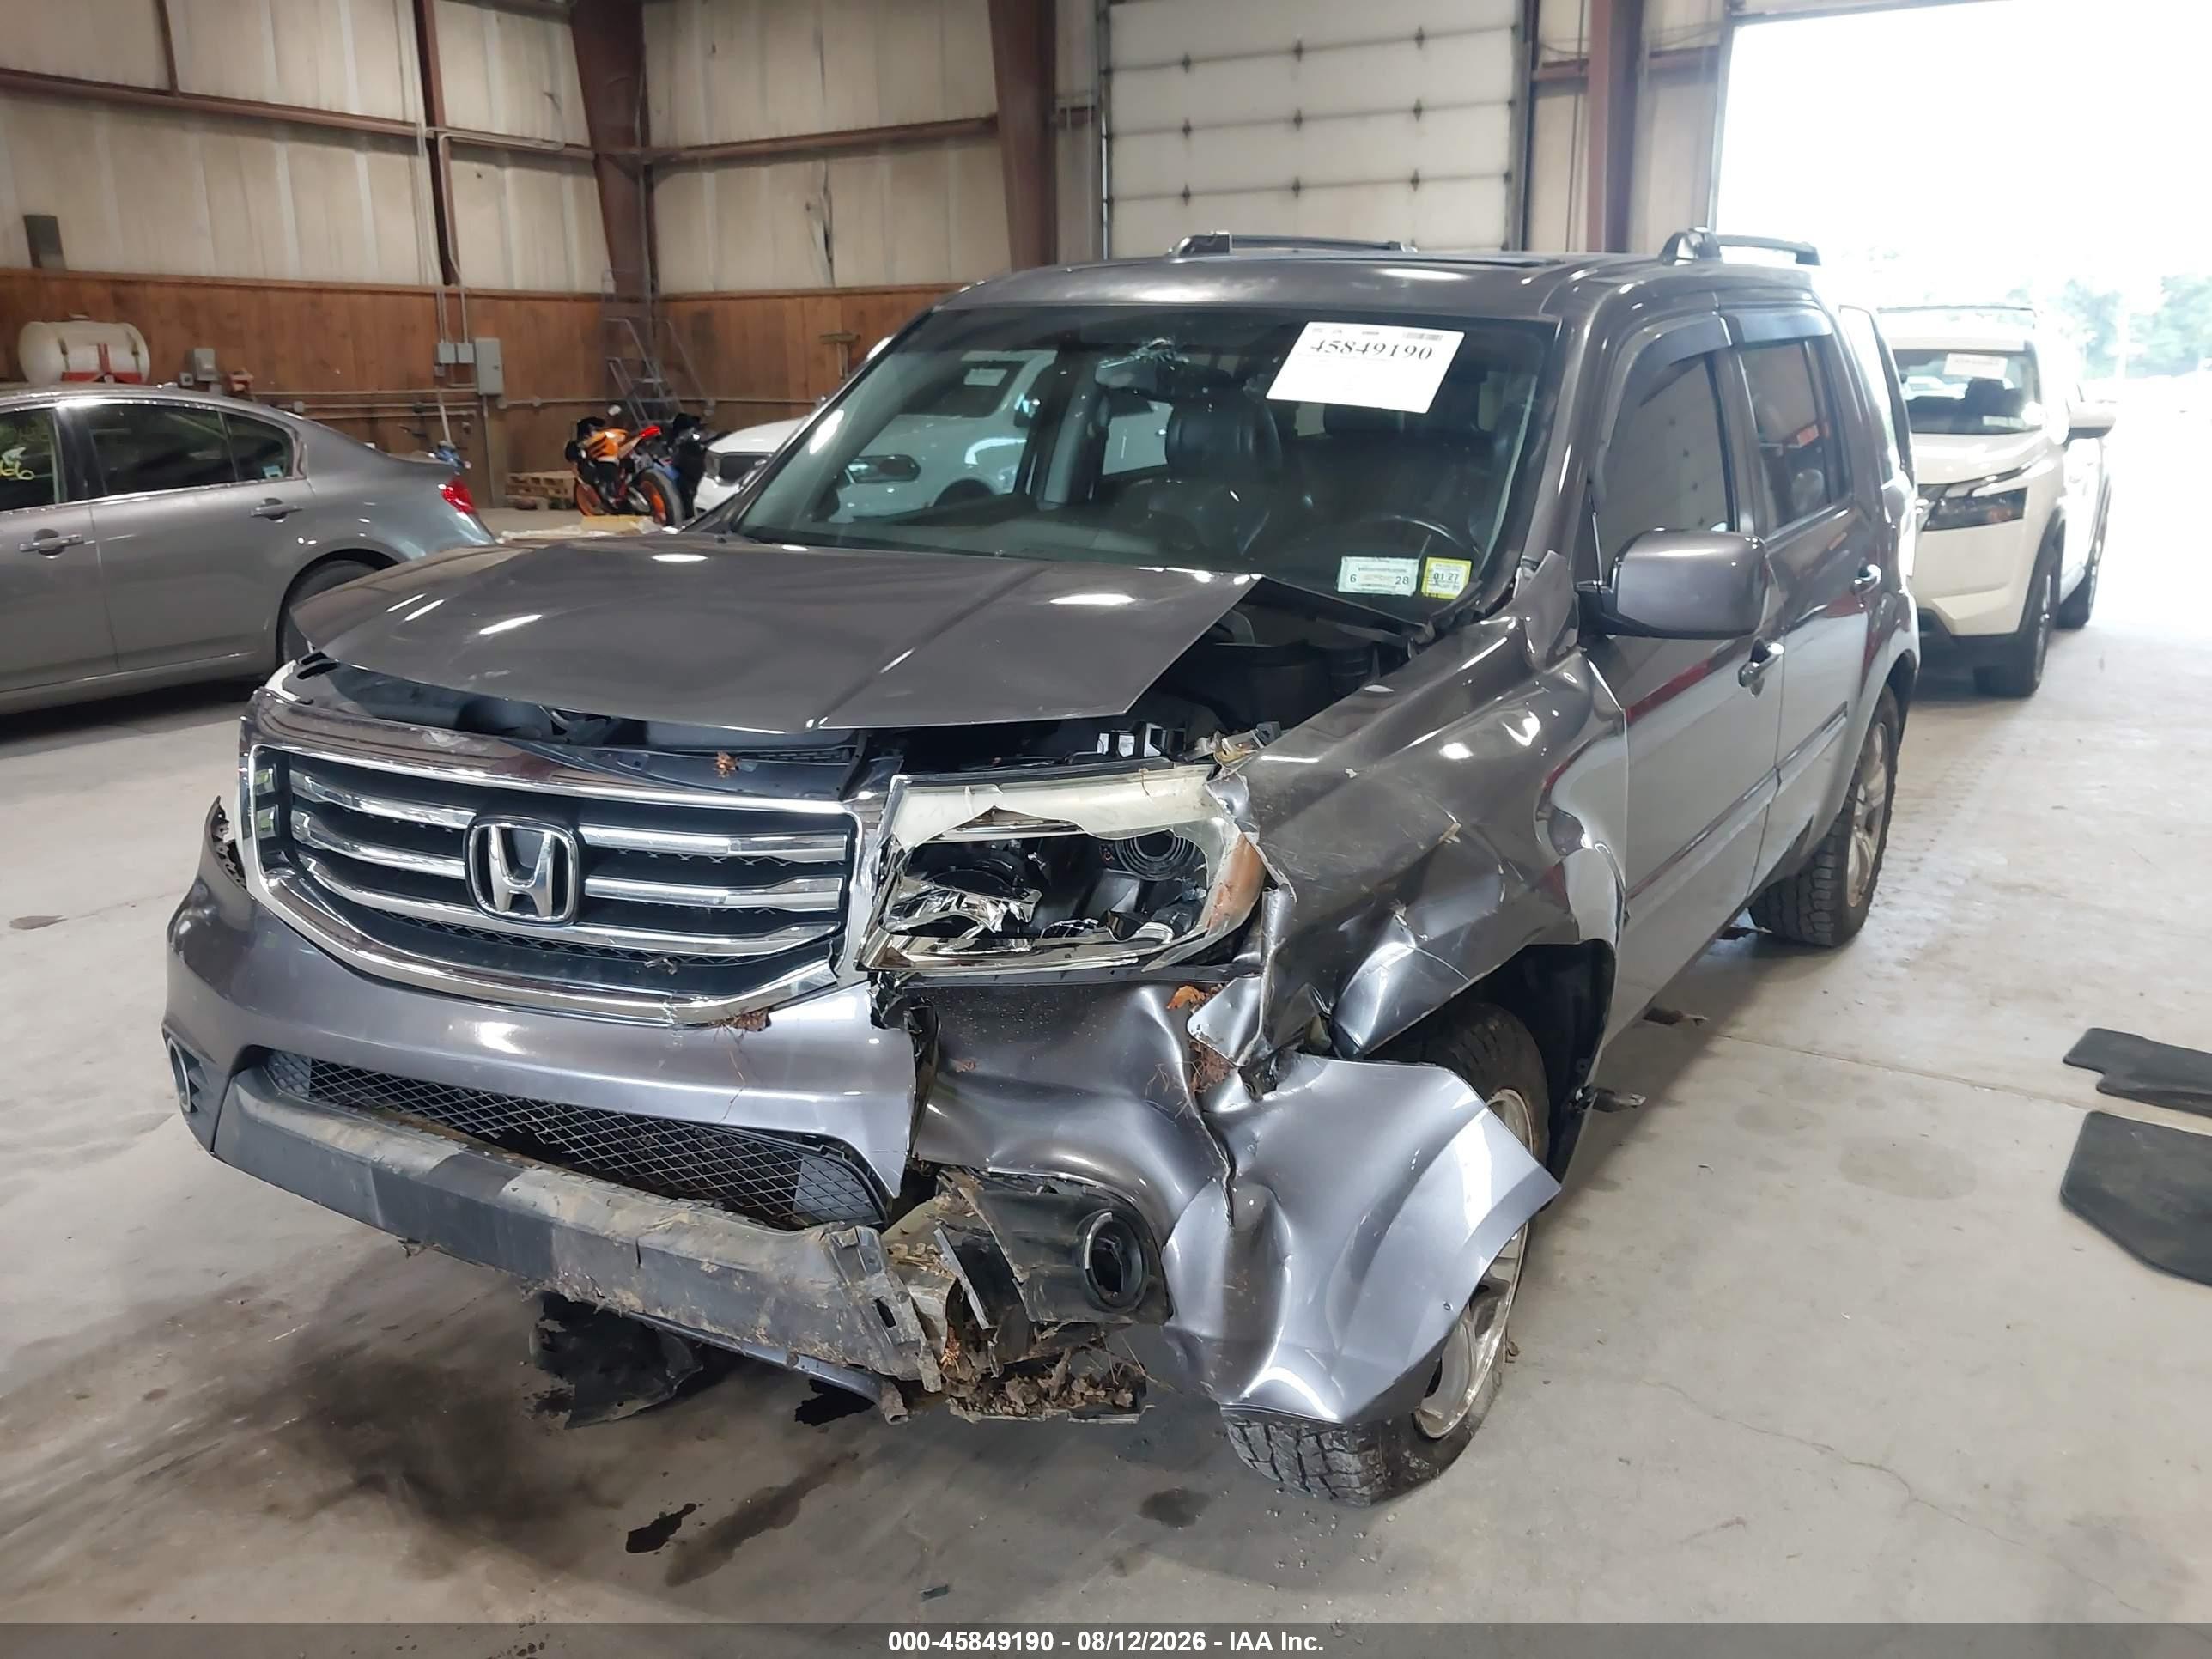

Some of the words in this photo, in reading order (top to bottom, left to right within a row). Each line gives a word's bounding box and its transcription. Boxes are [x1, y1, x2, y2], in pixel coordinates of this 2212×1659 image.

[1310, 339, 1433, 361] 45849190
[1350, 574, 1357, 583] 6
[1395, 576, 1409, 585] 28
[488, 823, 555, 918] H
